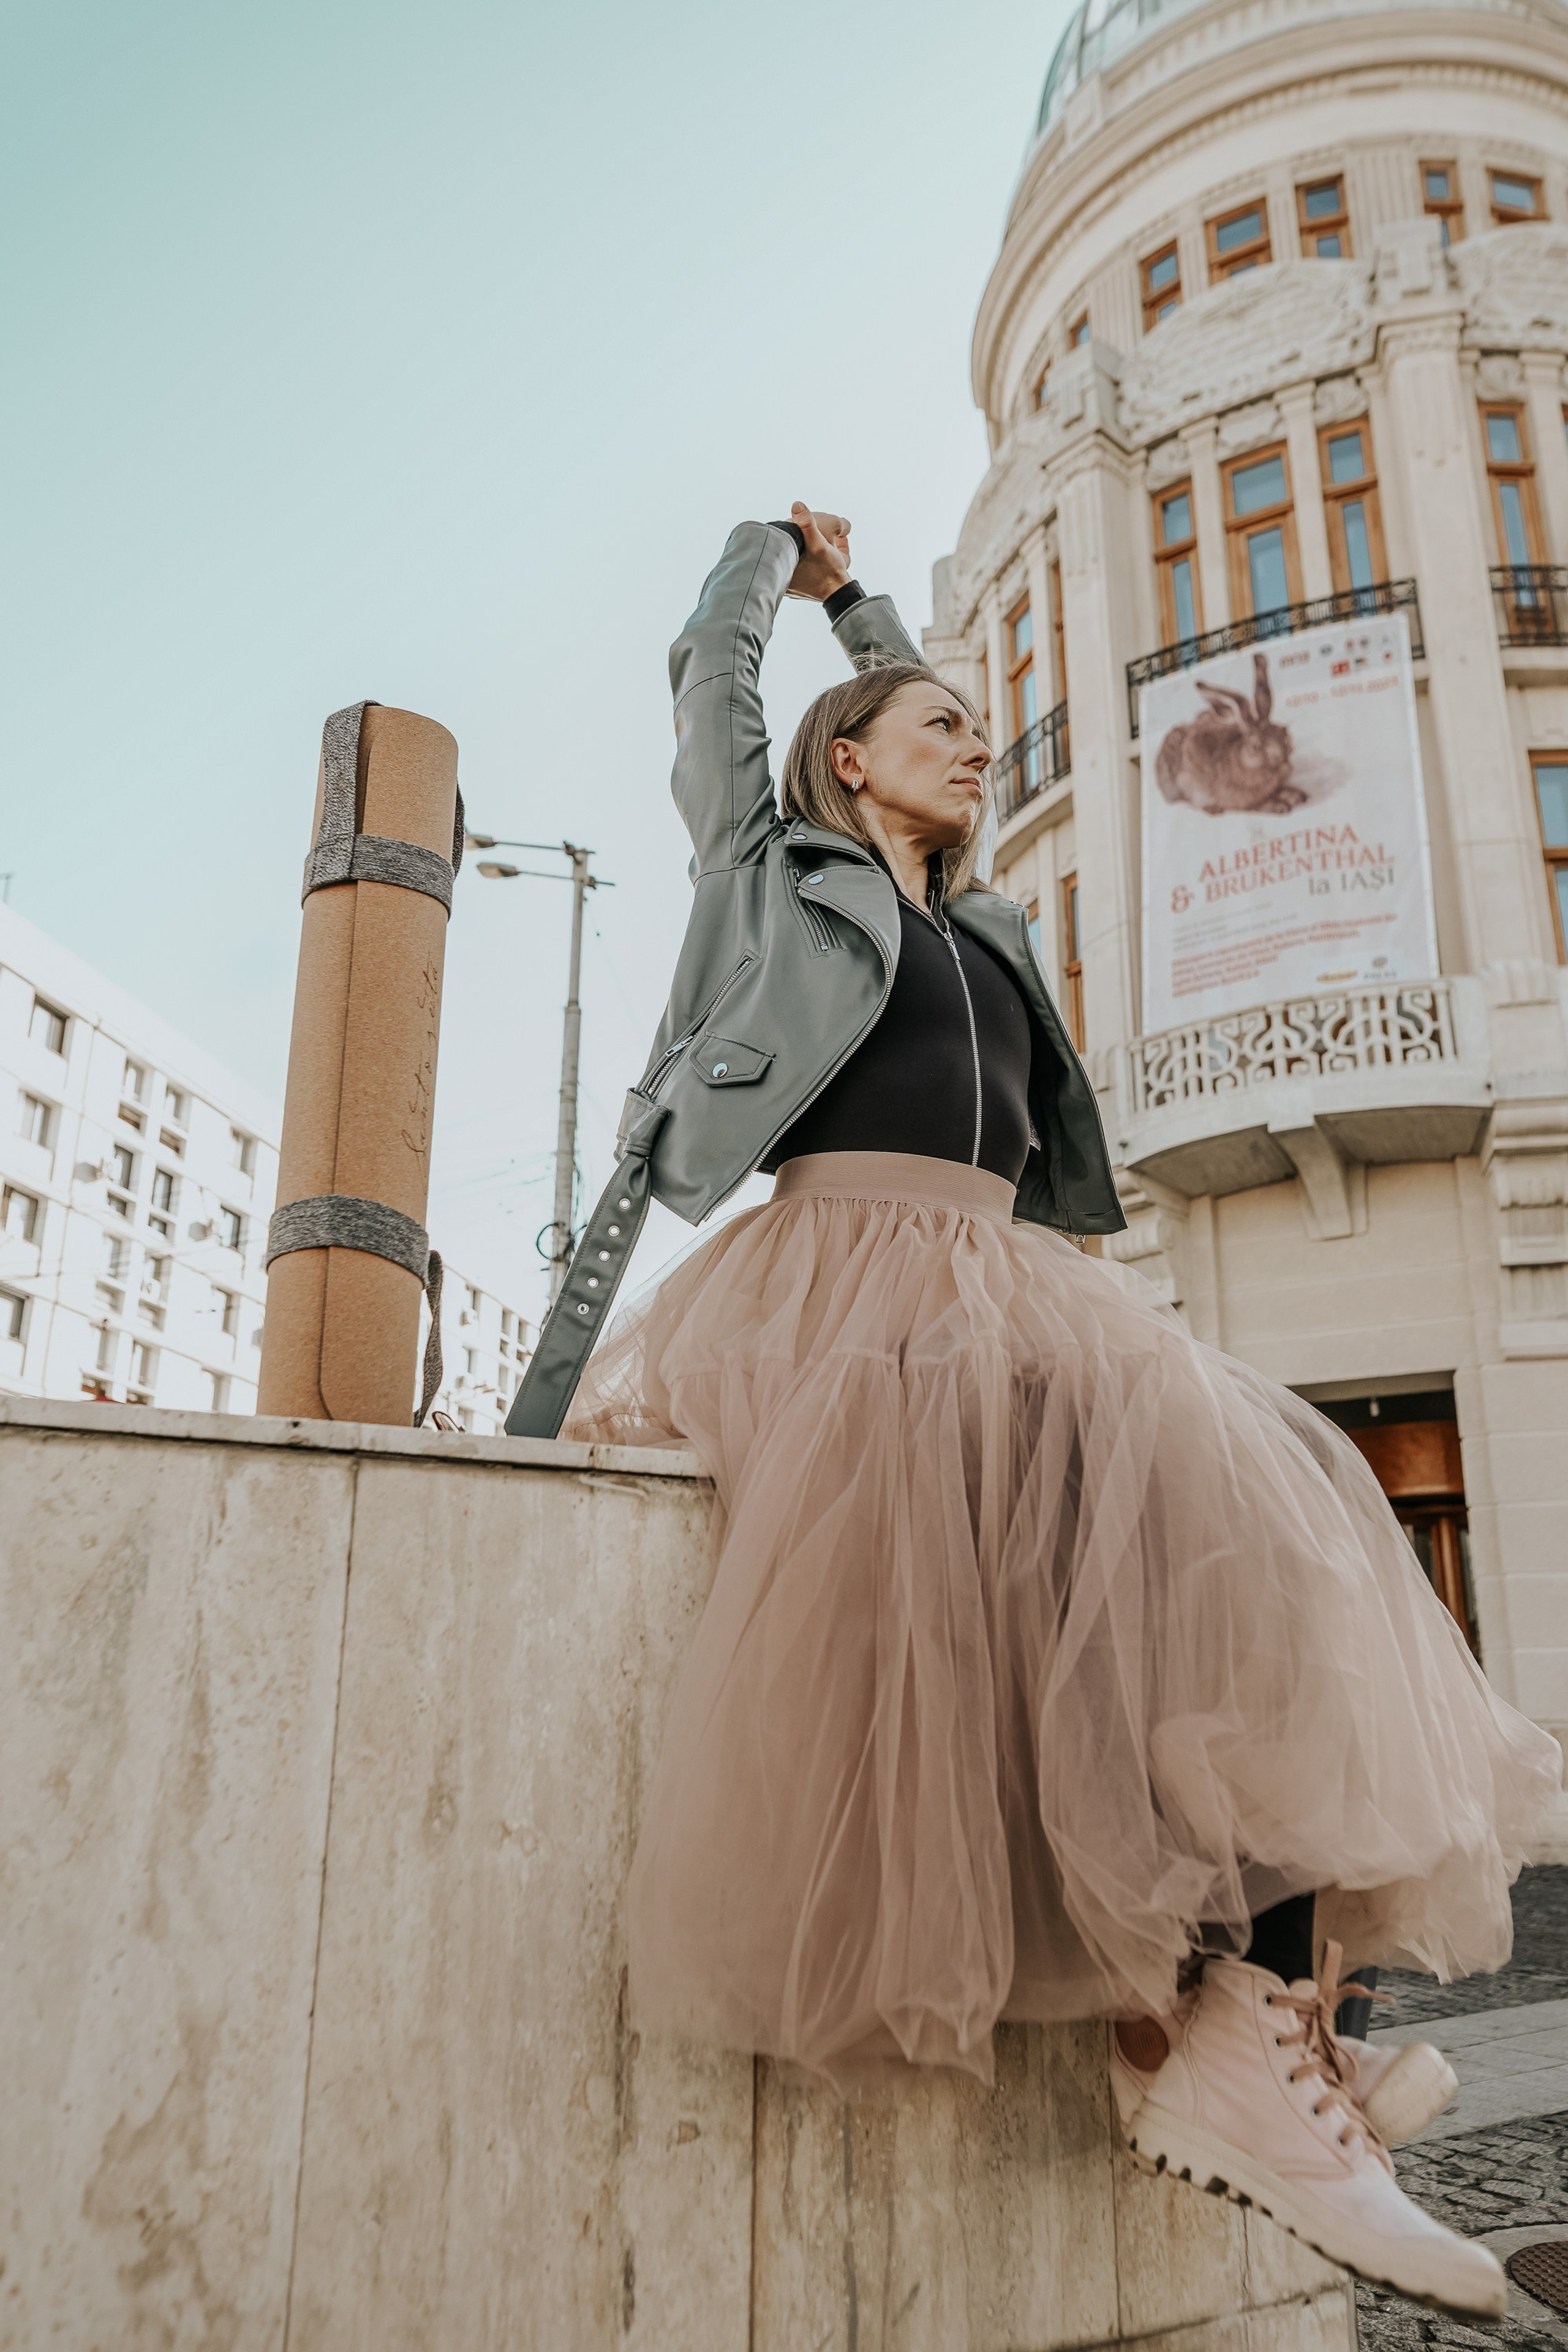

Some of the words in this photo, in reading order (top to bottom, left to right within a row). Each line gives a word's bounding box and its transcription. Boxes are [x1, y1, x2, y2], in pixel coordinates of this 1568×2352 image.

[1170, 884, 1194, 914] &
[1205, 842, 1396, 903] BRUKENTHAL
[1198, 823, 1360, 883] ALBERTINA
[1309, 875, 1330, 897] la
